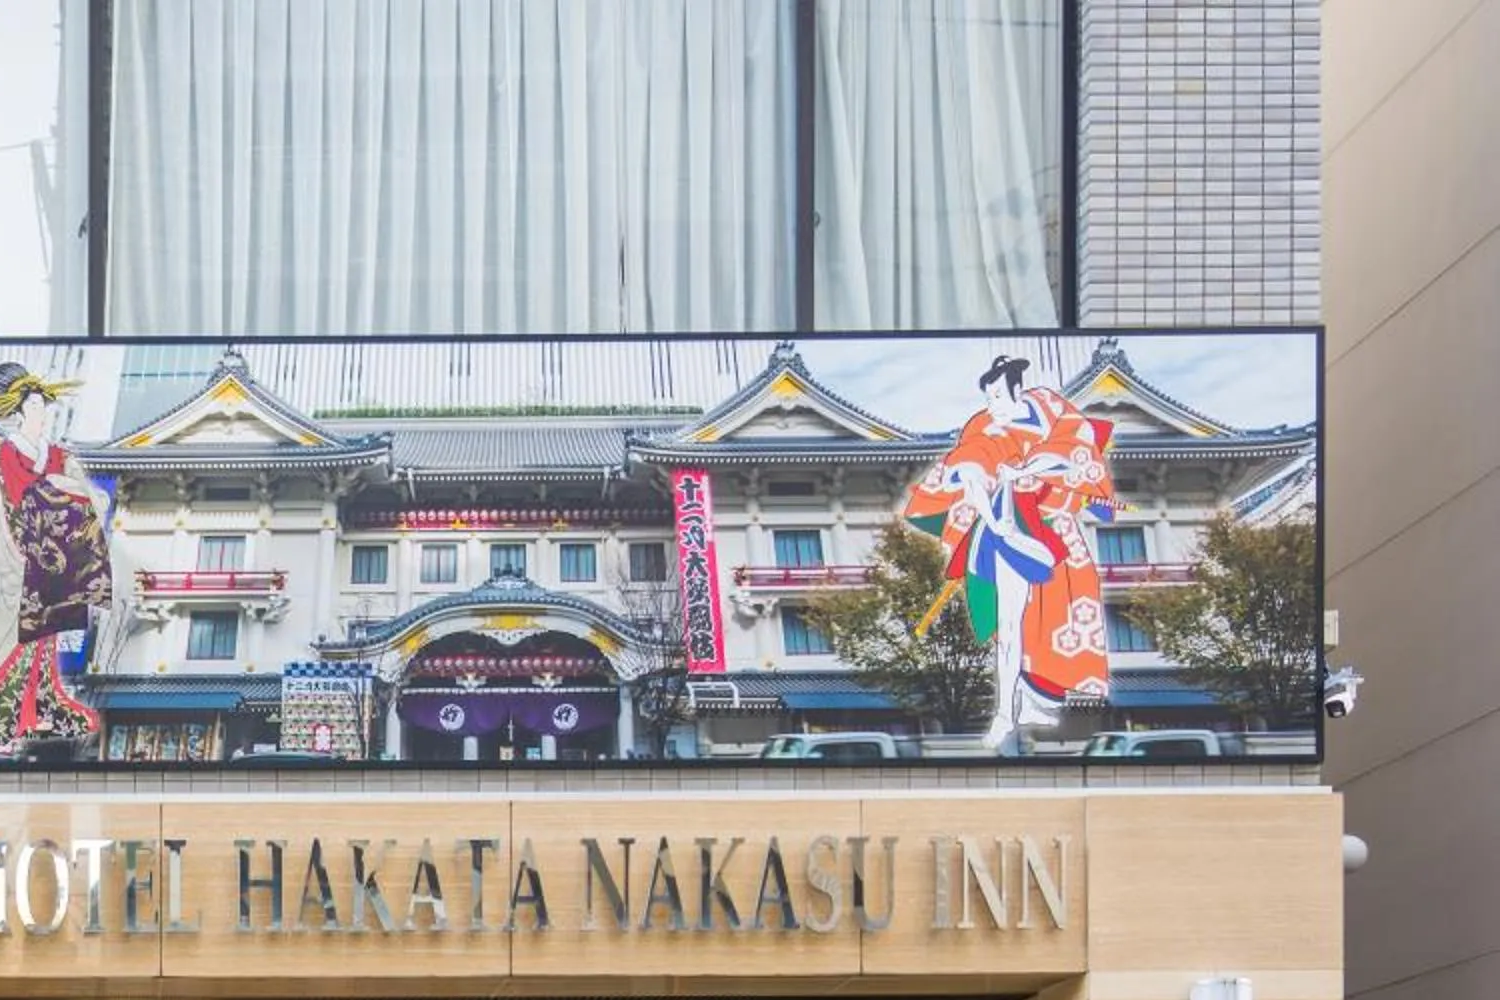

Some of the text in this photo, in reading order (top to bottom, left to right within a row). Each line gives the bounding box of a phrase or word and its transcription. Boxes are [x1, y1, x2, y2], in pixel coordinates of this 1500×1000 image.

[232, 837, 551, 933] HAKATA
[580, 835, 898, 931] NAKASU
[929, 835, 1072, 930] INN
